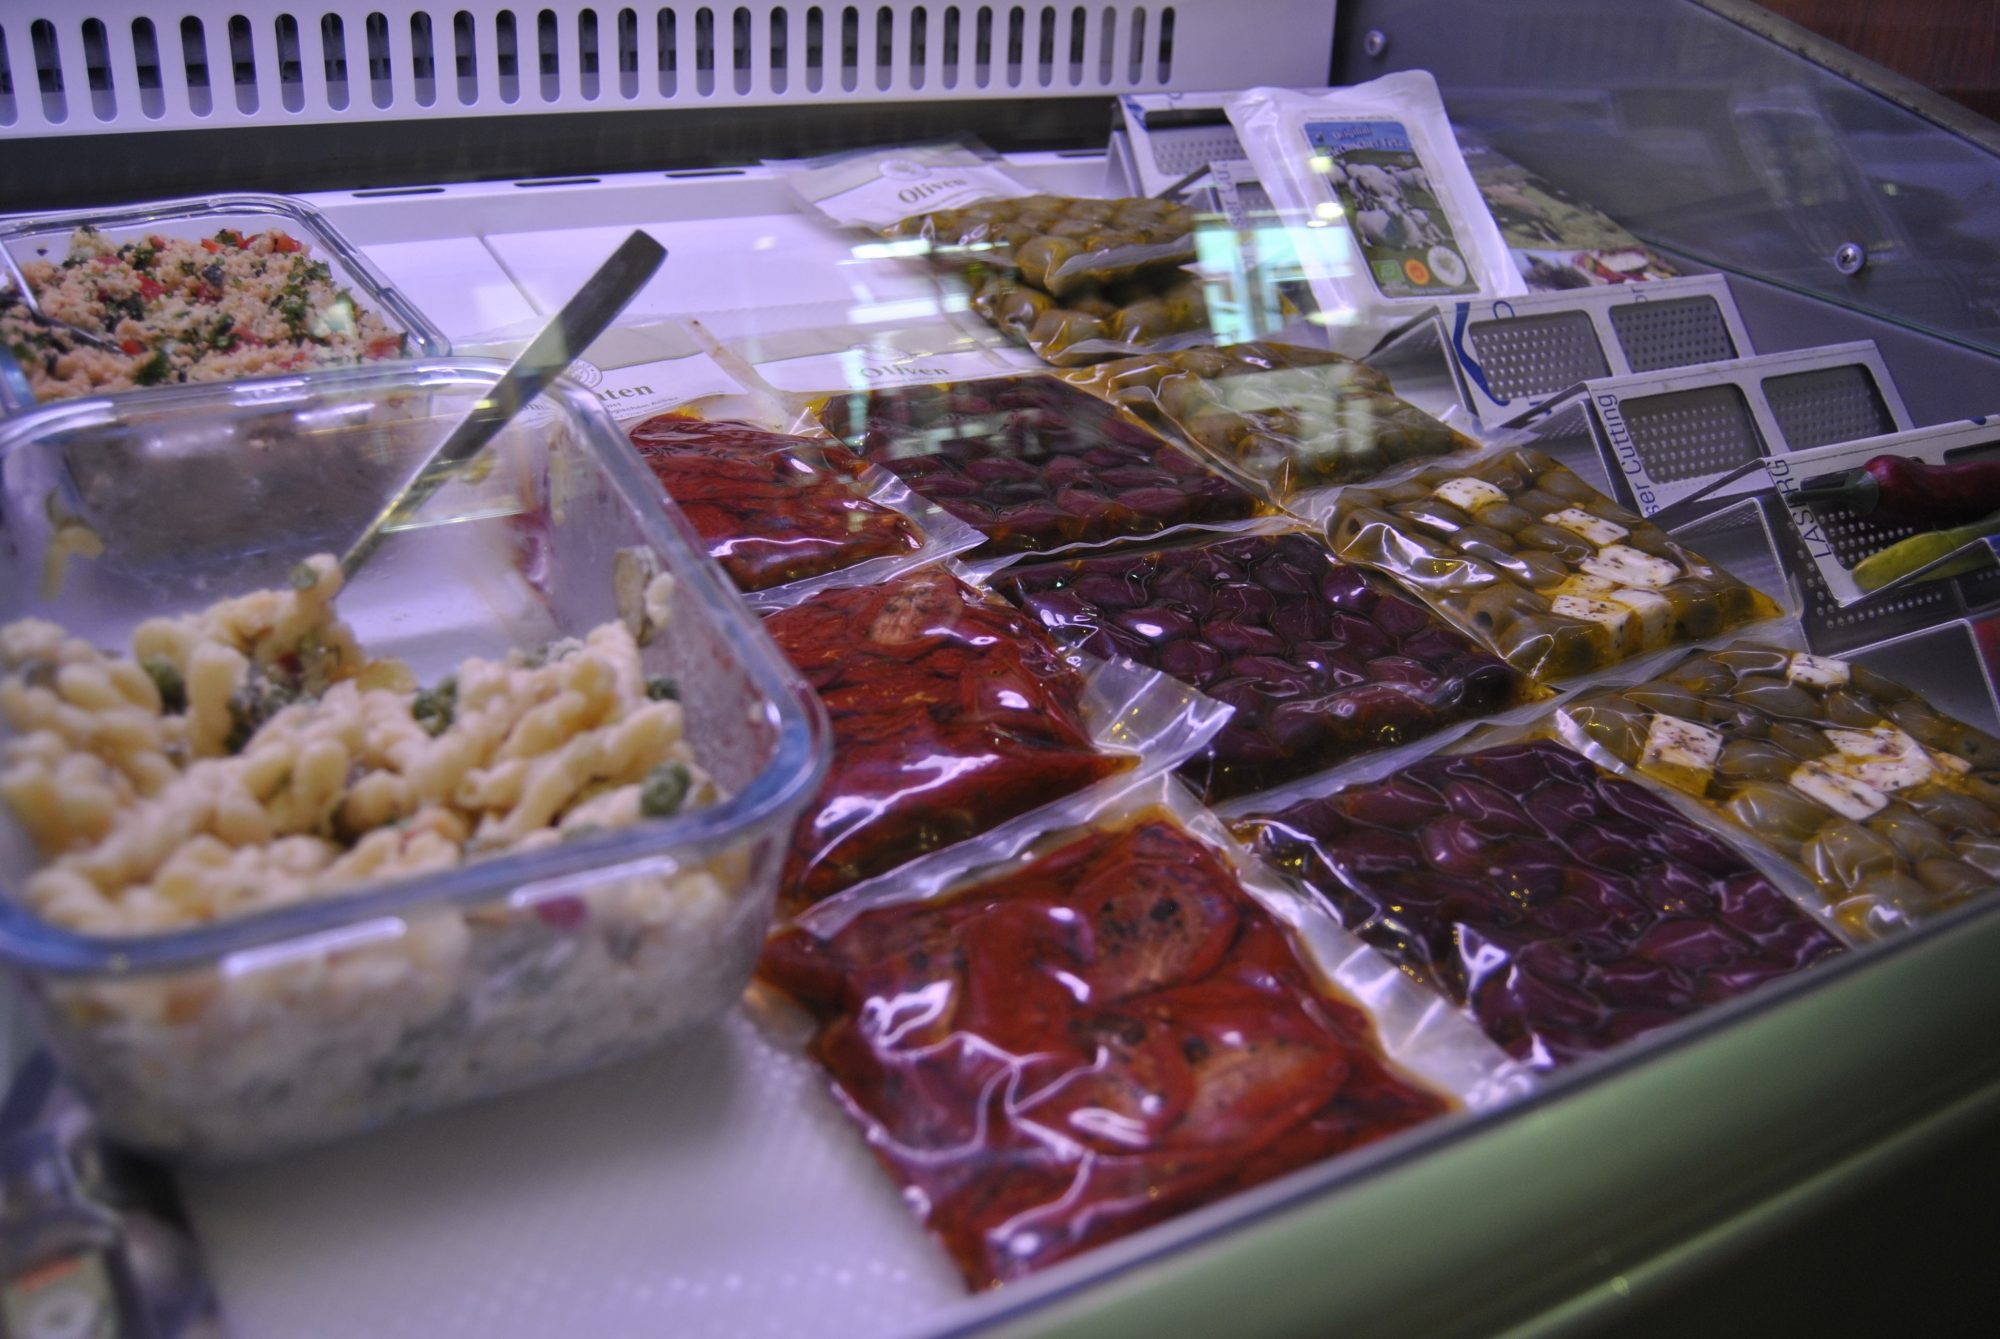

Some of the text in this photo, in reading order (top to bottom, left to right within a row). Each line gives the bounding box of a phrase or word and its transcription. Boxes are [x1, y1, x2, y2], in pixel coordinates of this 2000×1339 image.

[897, 178, 968, 204] Oliven
[859, 363, 951, 379] Oliven
[1596, 394, 1642, 475] Cutting
